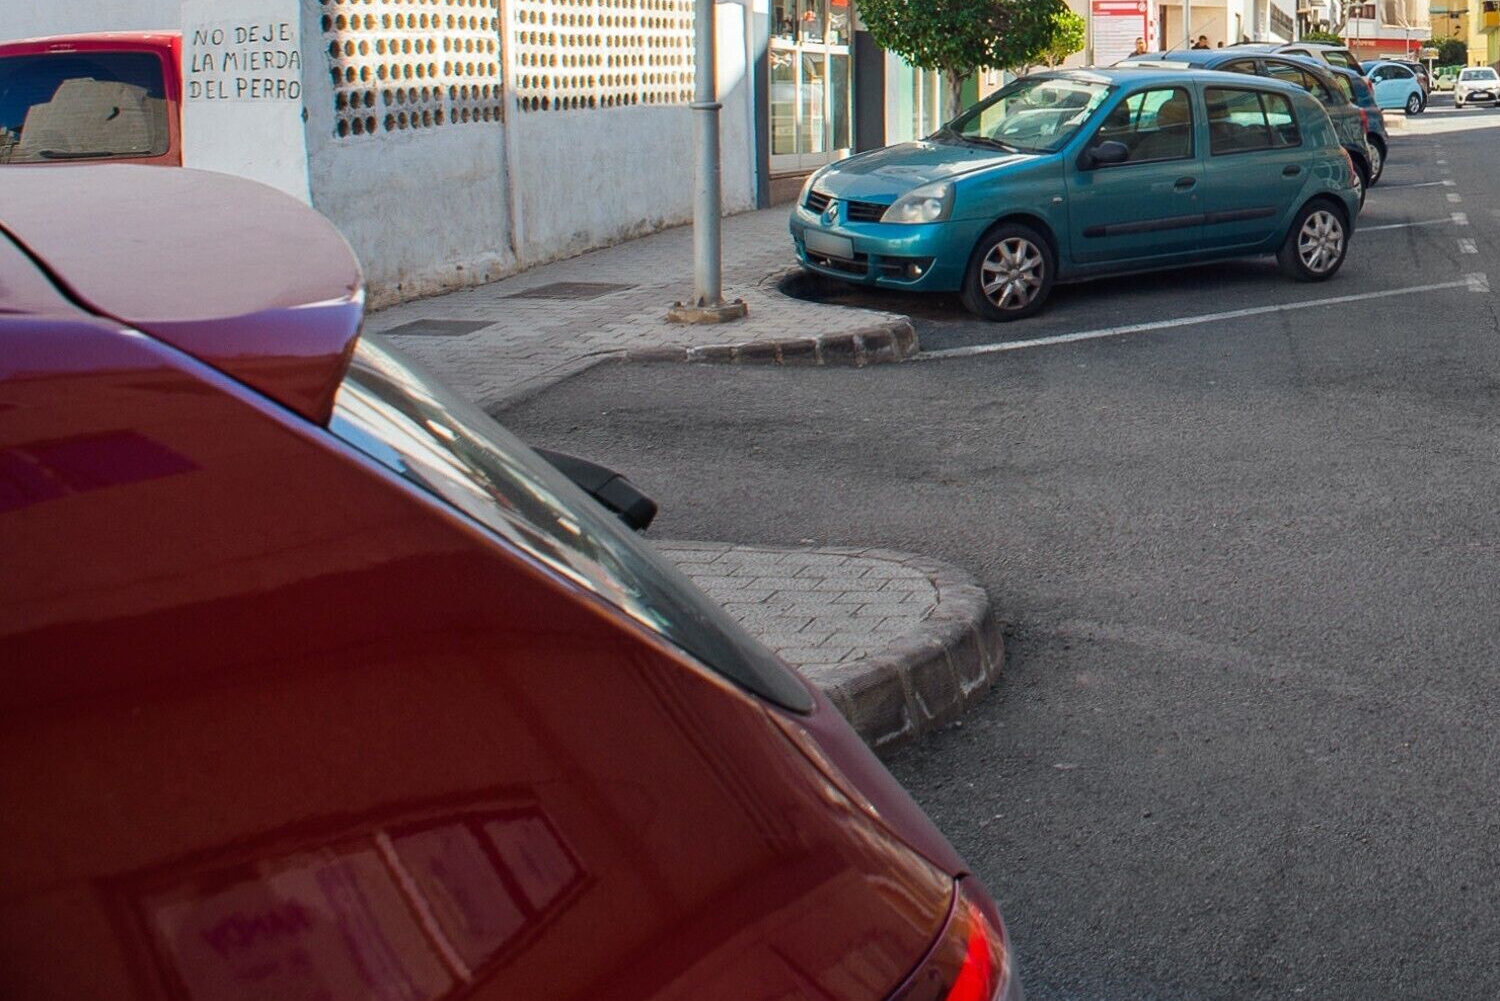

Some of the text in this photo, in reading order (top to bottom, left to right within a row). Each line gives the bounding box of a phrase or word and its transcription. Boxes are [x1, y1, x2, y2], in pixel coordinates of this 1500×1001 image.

[193, 23, 290, 46] NO DEJE
[192, 53, 214, 73] LA
[190, 77, 300, 99] DEL PERRO
